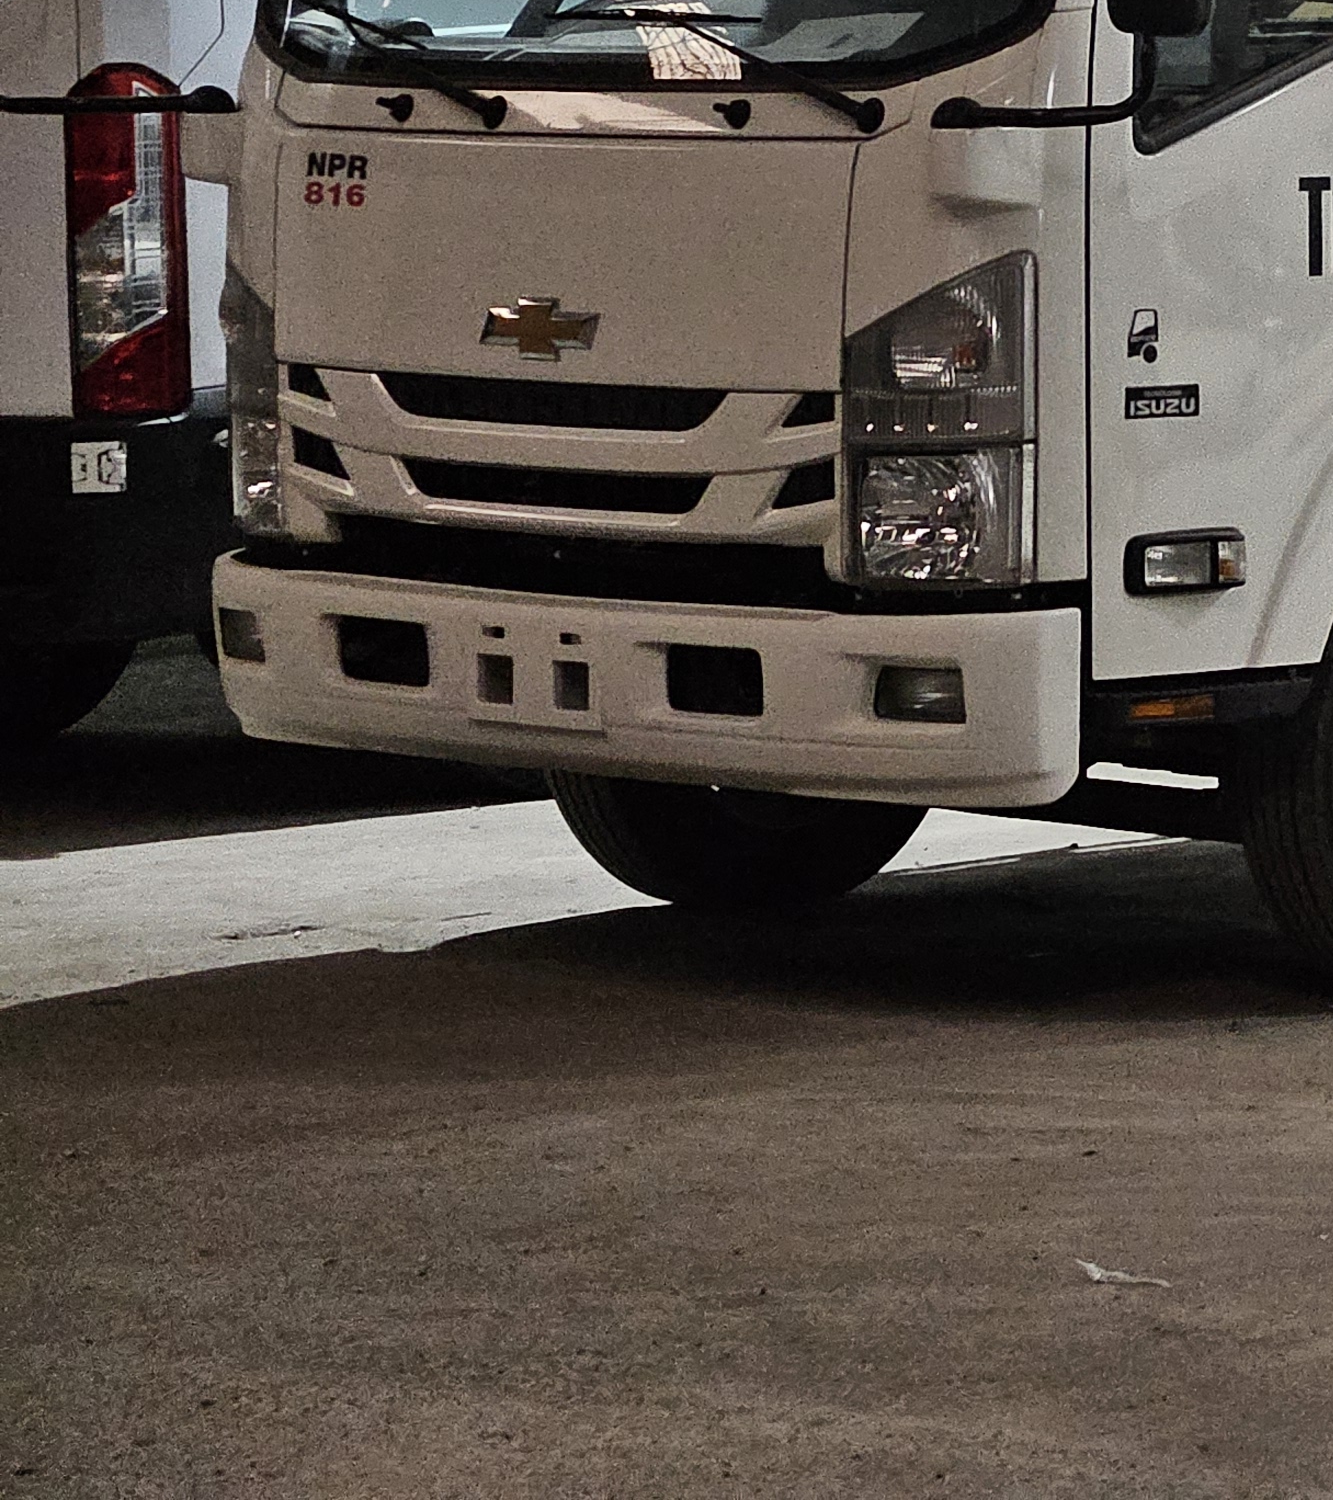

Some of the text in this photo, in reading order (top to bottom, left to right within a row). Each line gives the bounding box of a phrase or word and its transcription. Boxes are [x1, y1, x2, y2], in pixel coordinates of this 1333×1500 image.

[306, 151, 368, 180] NPR
[304, 181, 367, 207] 816
[1129, 396, 1196, 417] ISUZU
